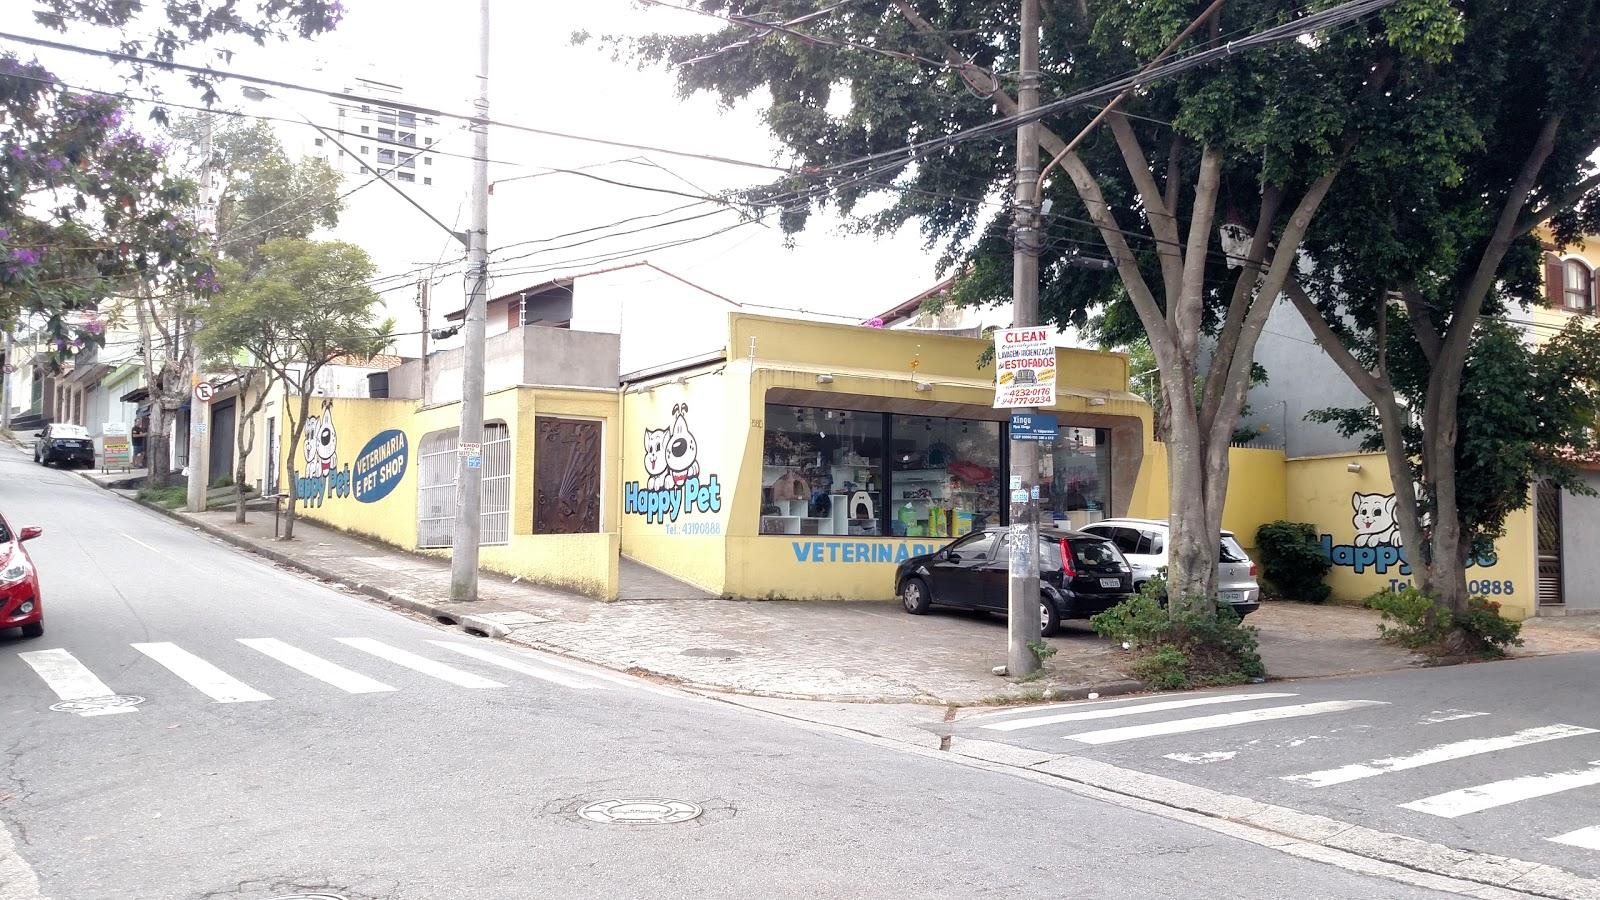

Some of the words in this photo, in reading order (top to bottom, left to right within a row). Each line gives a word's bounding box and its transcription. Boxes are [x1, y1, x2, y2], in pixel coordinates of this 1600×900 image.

[1005, 331, 1046, 343] CLEAN
[1005, 358, 1054, 369] ESTOFADOS
[1013, 416, 1031, 425] Xingu
[356, 480, 362, 497] E
[364, 471, 378, 494] PET
[380, 455, 404, 484] SHOP
[295, 470, 326, 508] appy
[328, 462, 351, 499] Pet
[625, 481, 682, 524] Happy
[684, 474, 721, 513] Pet
[682, 522, 721, 535] 43190888
